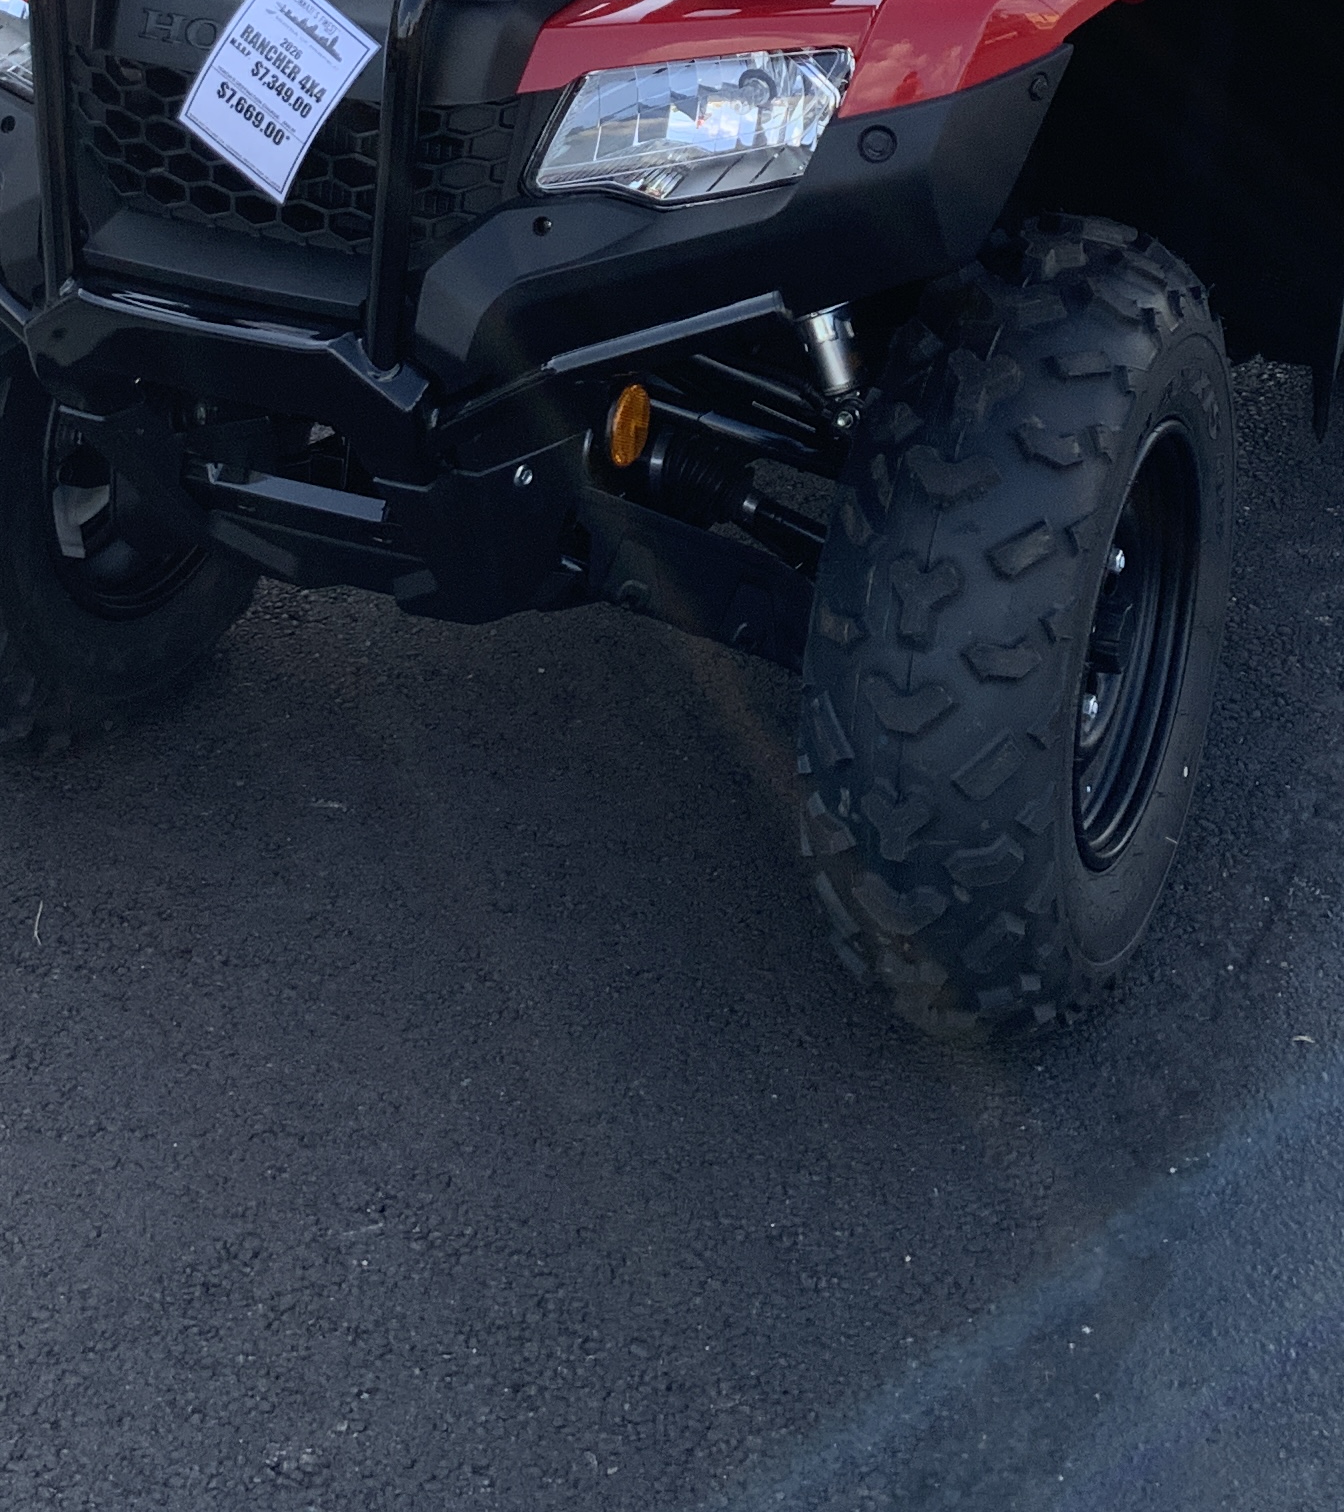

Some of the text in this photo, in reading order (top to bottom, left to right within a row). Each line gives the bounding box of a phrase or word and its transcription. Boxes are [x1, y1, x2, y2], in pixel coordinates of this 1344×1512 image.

[239, 24, 302, 82] RANCHER
[298, 74, 327, 104] 4X4
[279, 37, 304, 60] 2026
[251, 60, 312, 119] $7,349.00
